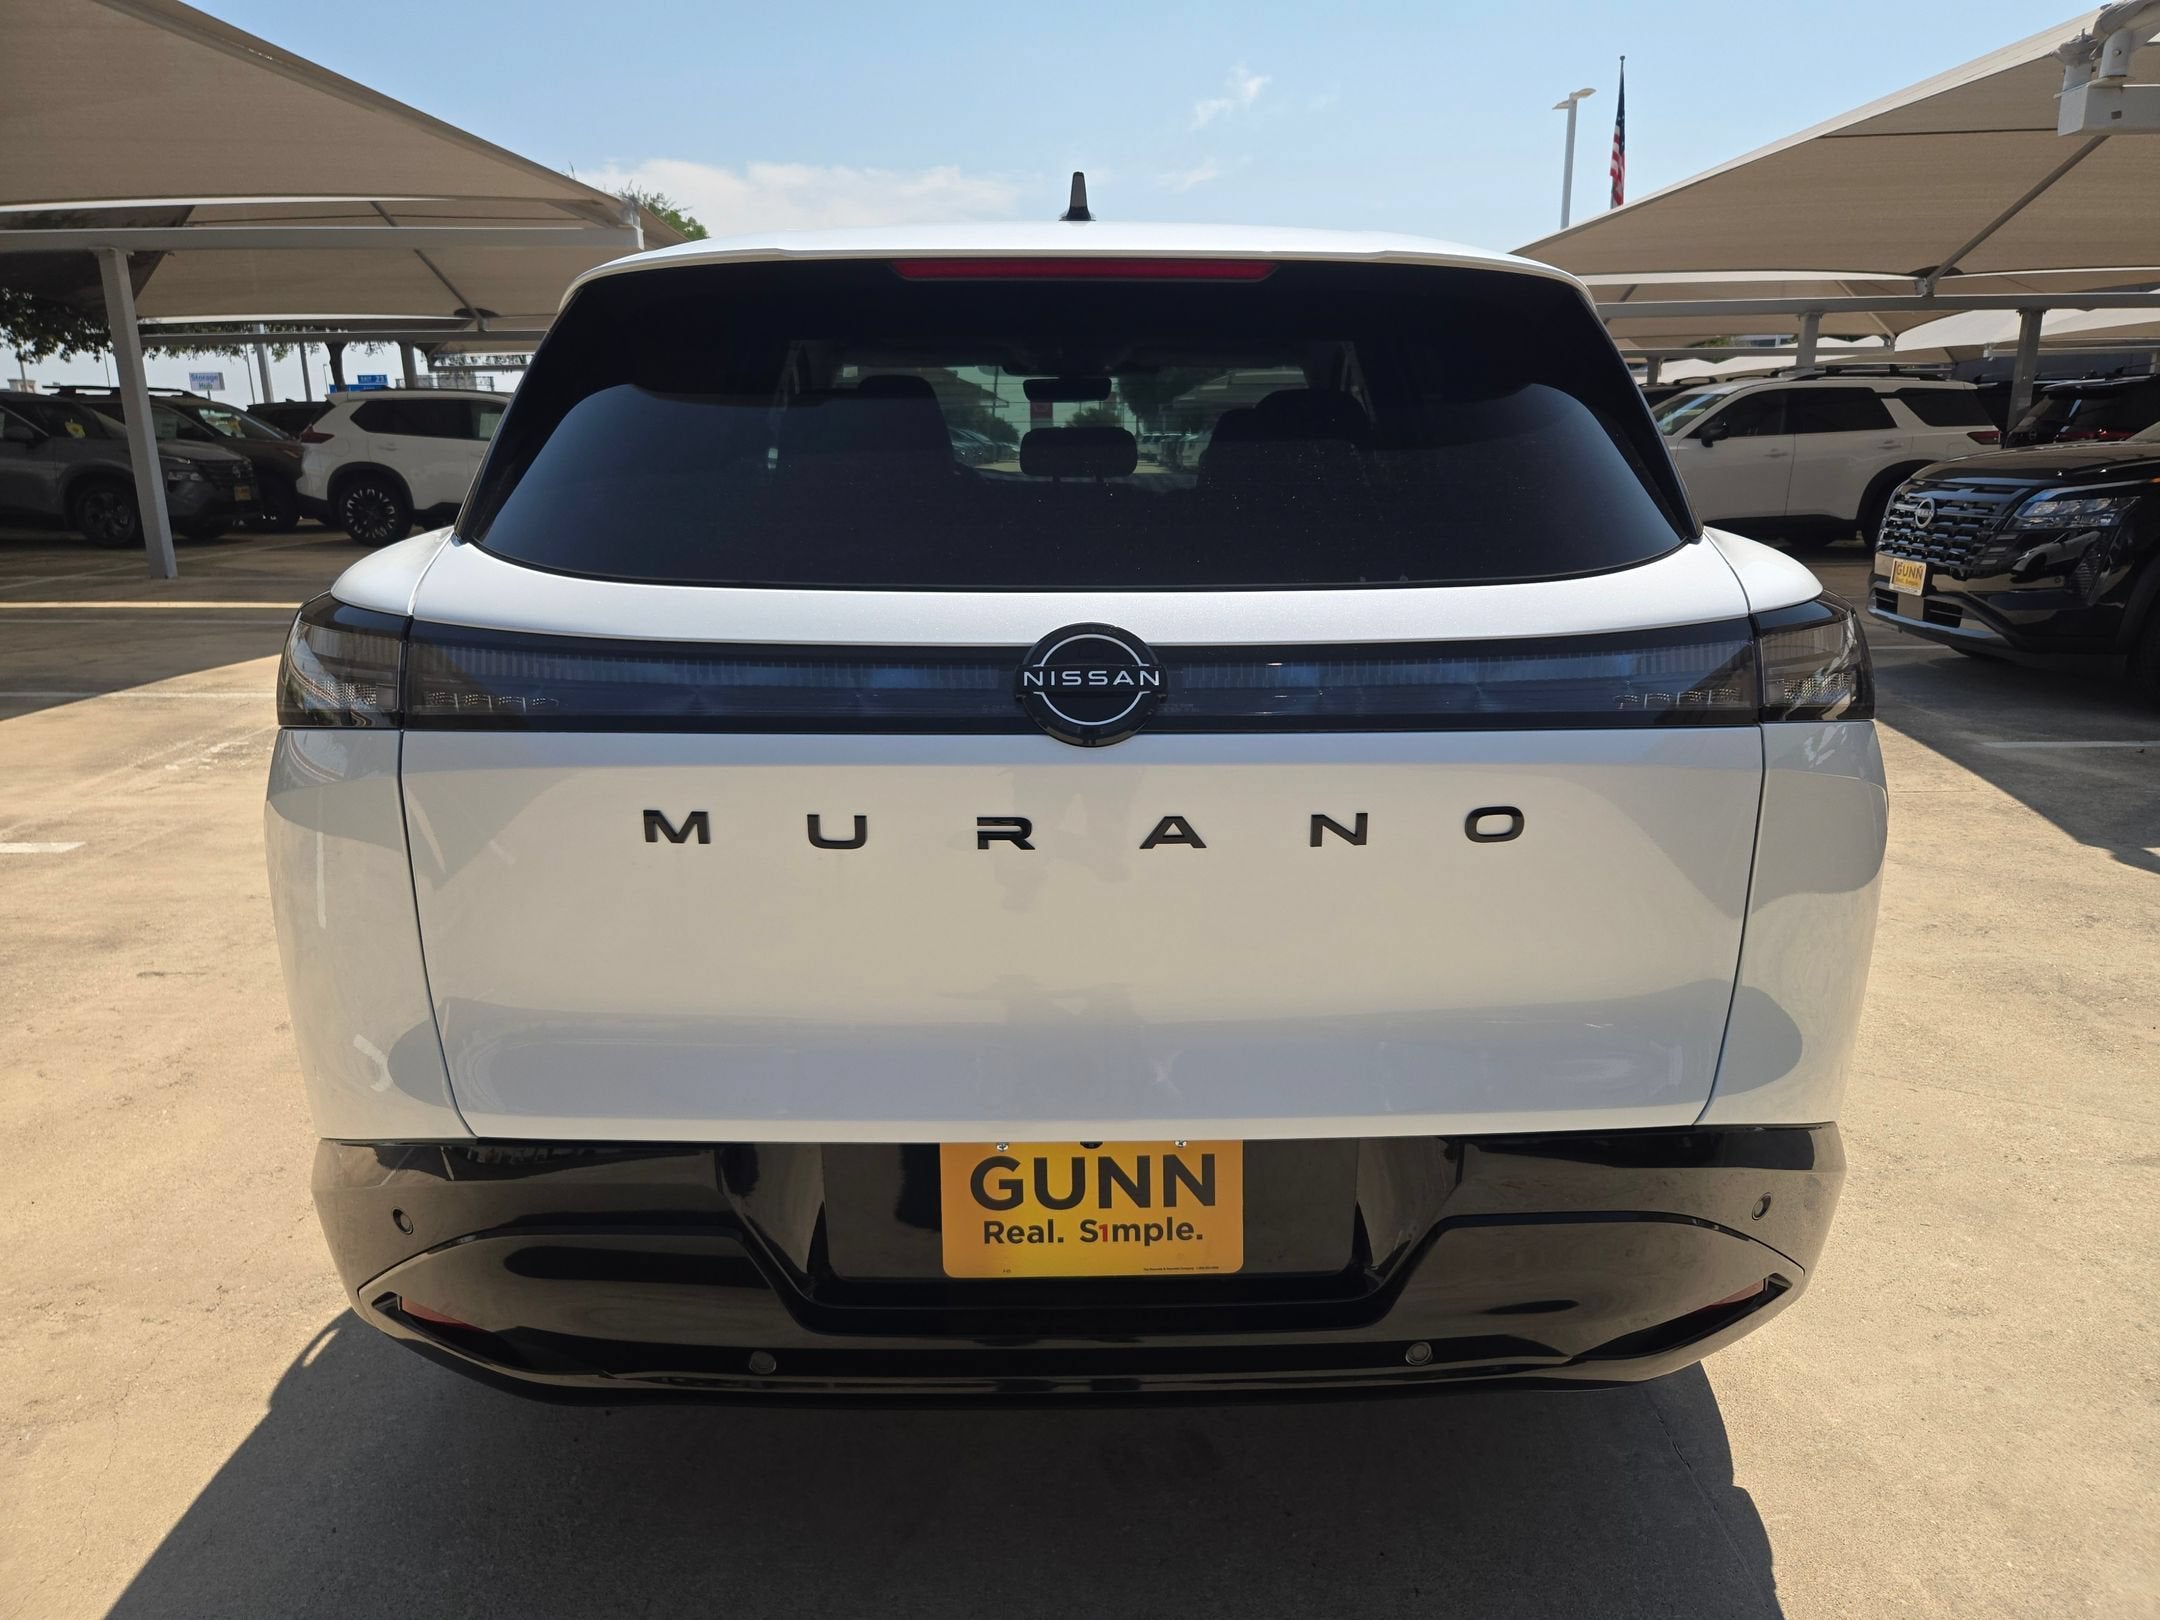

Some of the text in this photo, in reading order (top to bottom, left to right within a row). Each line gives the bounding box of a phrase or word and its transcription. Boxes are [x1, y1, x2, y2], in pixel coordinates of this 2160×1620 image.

[191, 374, 219, 383] Storage
[1896, 564, 1924, 580] GUNN
[1023, 670, 1160, 687] NISSAN
[642, 805, 1526, 851] MURANO
[969, 1153, 1217, 1211] GUNN
[983, 1218, 1065, 1245] Real.
